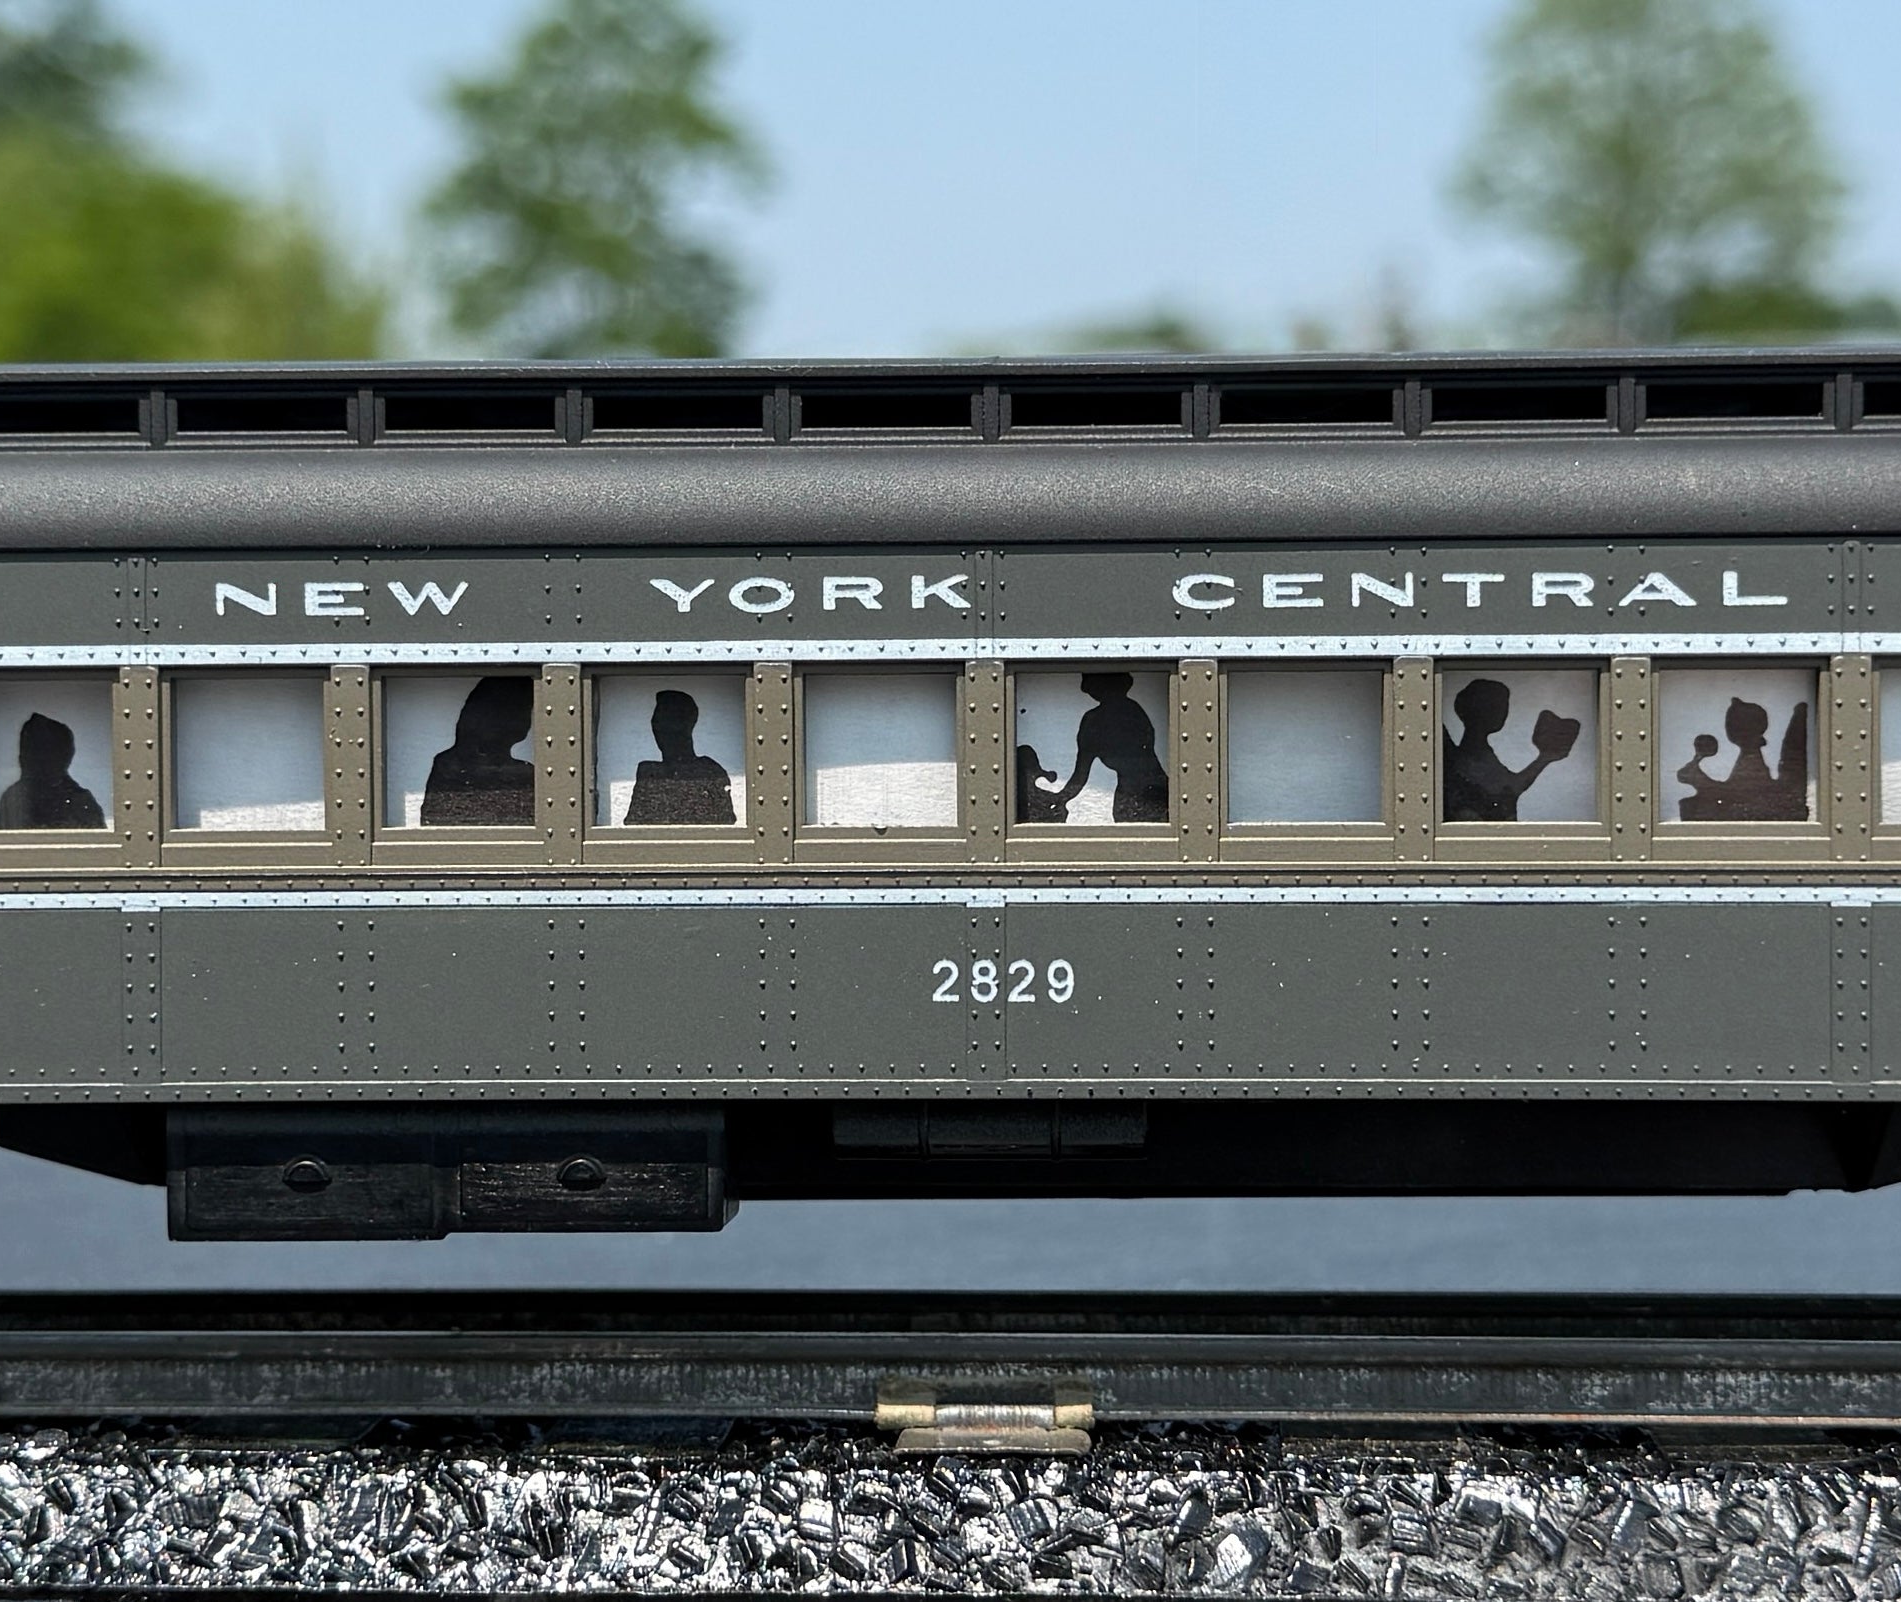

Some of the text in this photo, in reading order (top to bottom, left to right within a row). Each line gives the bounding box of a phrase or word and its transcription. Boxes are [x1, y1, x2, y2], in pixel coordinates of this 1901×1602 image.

[214, 570, 1789, 617] NEW YORK CENTRAL
[931, 958, 1076, 1005] 2829
